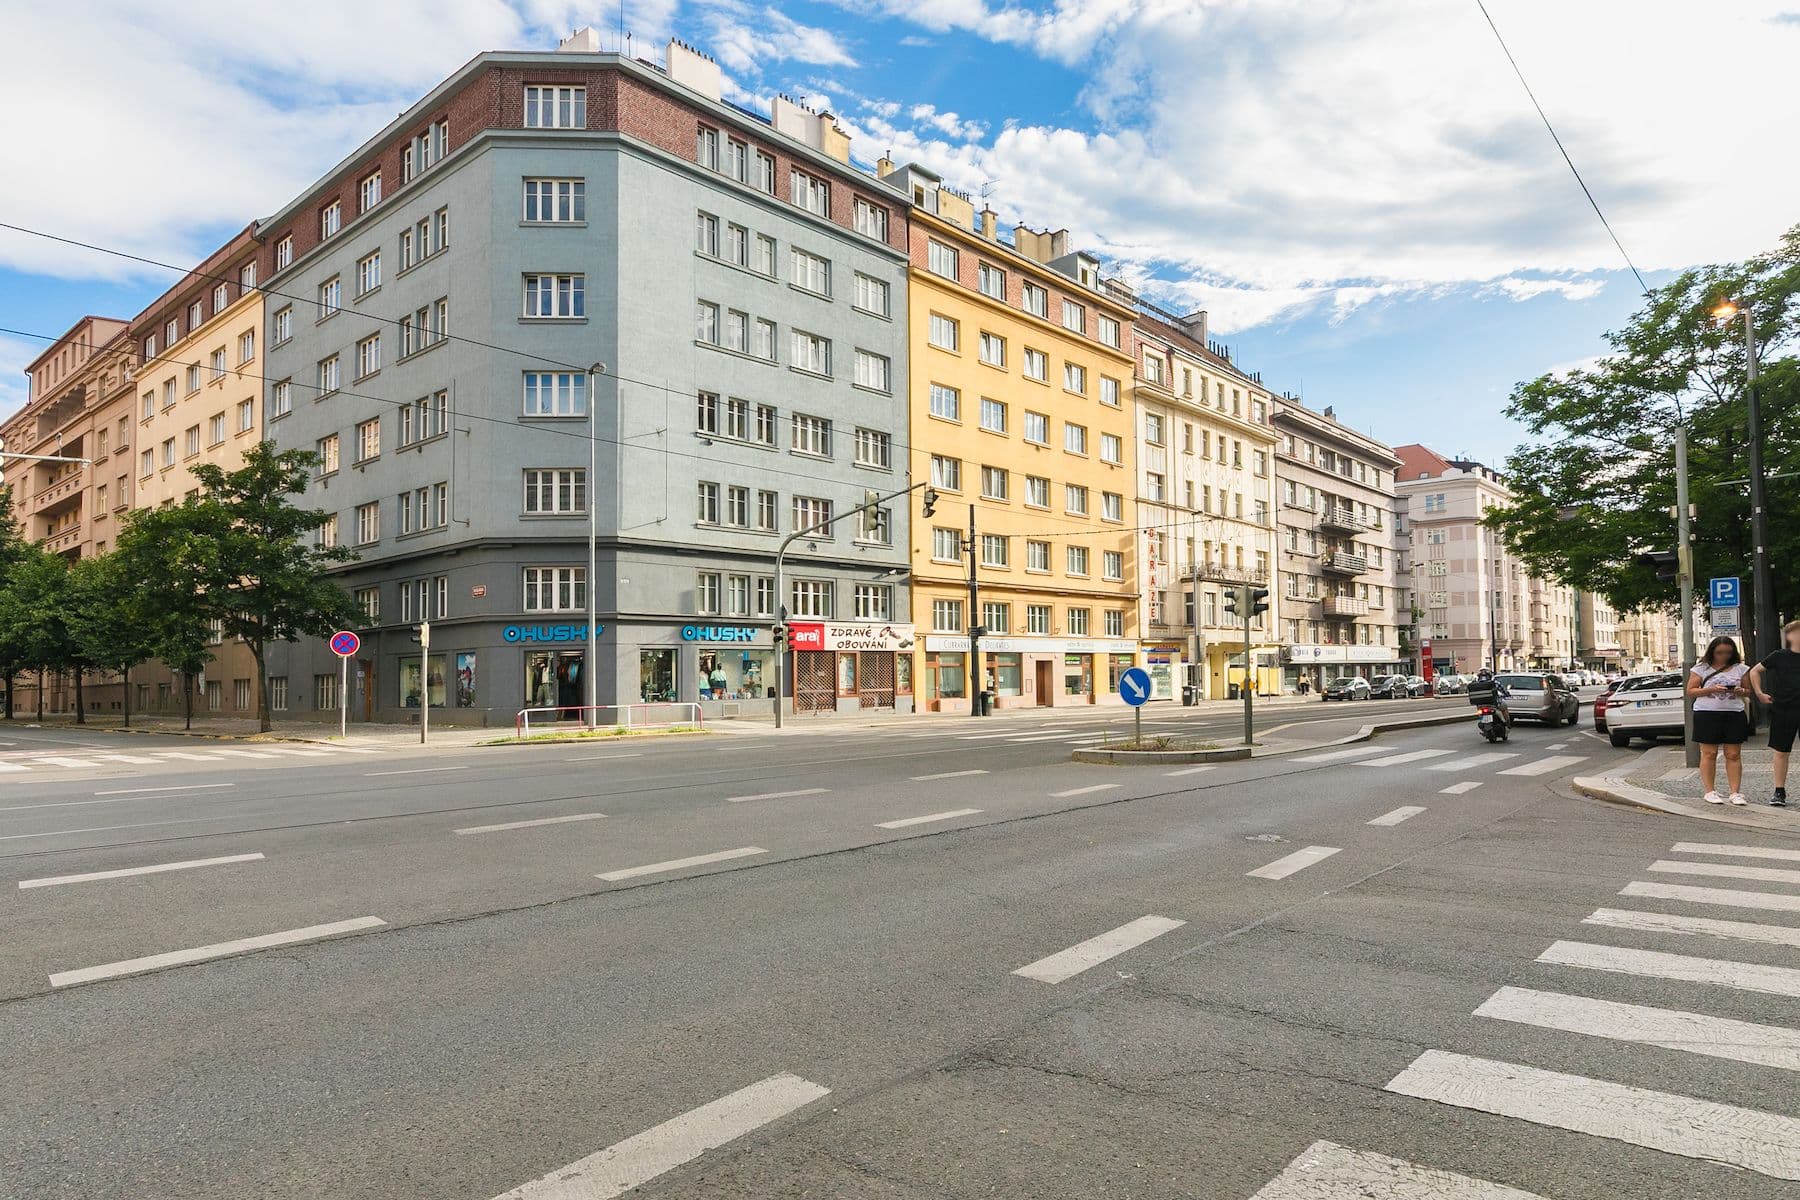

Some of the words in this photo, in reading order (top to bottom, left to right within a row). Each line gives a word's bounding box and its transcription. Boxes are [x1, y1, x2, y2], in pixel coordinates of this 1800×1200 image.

[1717, 582, 1733, 599] P
[831, 625, 872, 638] ZDRAVÉ
[837, 637, 887, 649] OBOUVÁNÍ
